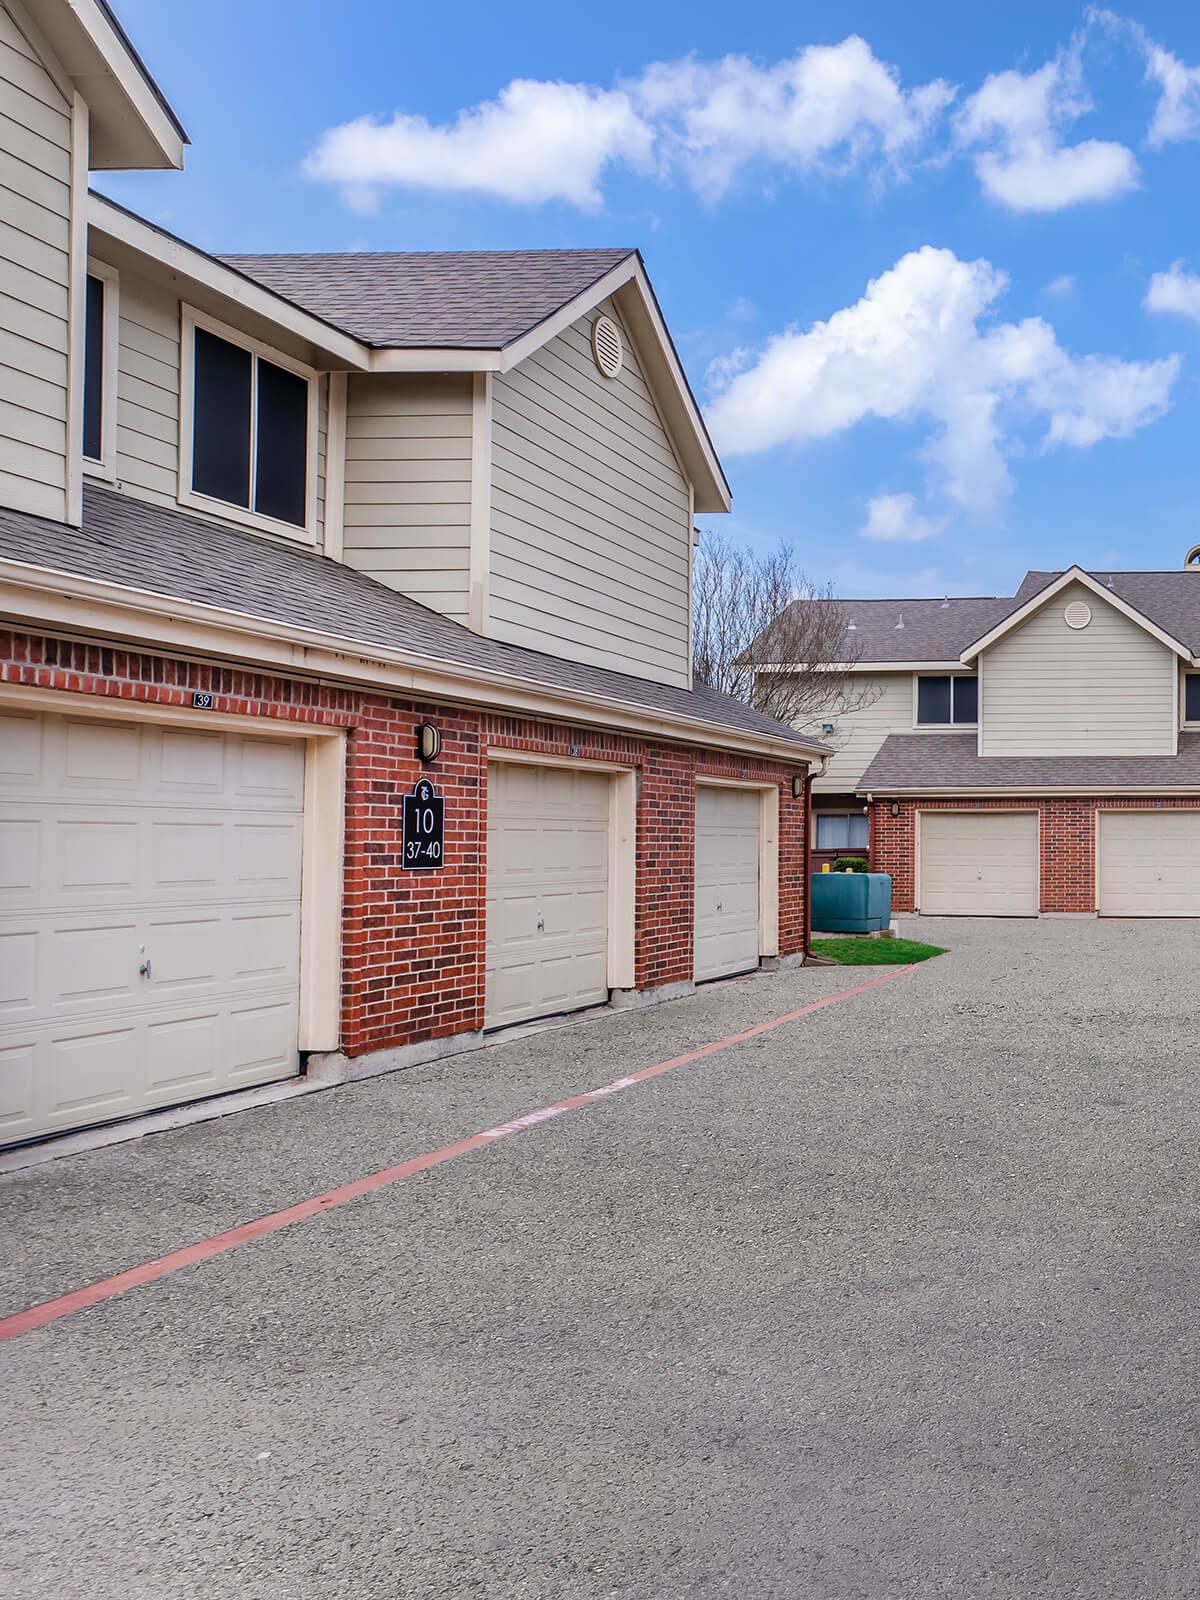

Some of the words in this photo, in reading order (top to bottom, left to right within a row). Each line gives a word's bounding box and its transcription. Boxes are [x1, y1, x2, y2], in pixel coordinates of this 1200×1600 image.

[197, 695, 209, 706] 39
[414, 808, 433, 833] 10
[406, 842, 440, 859] 37-40
